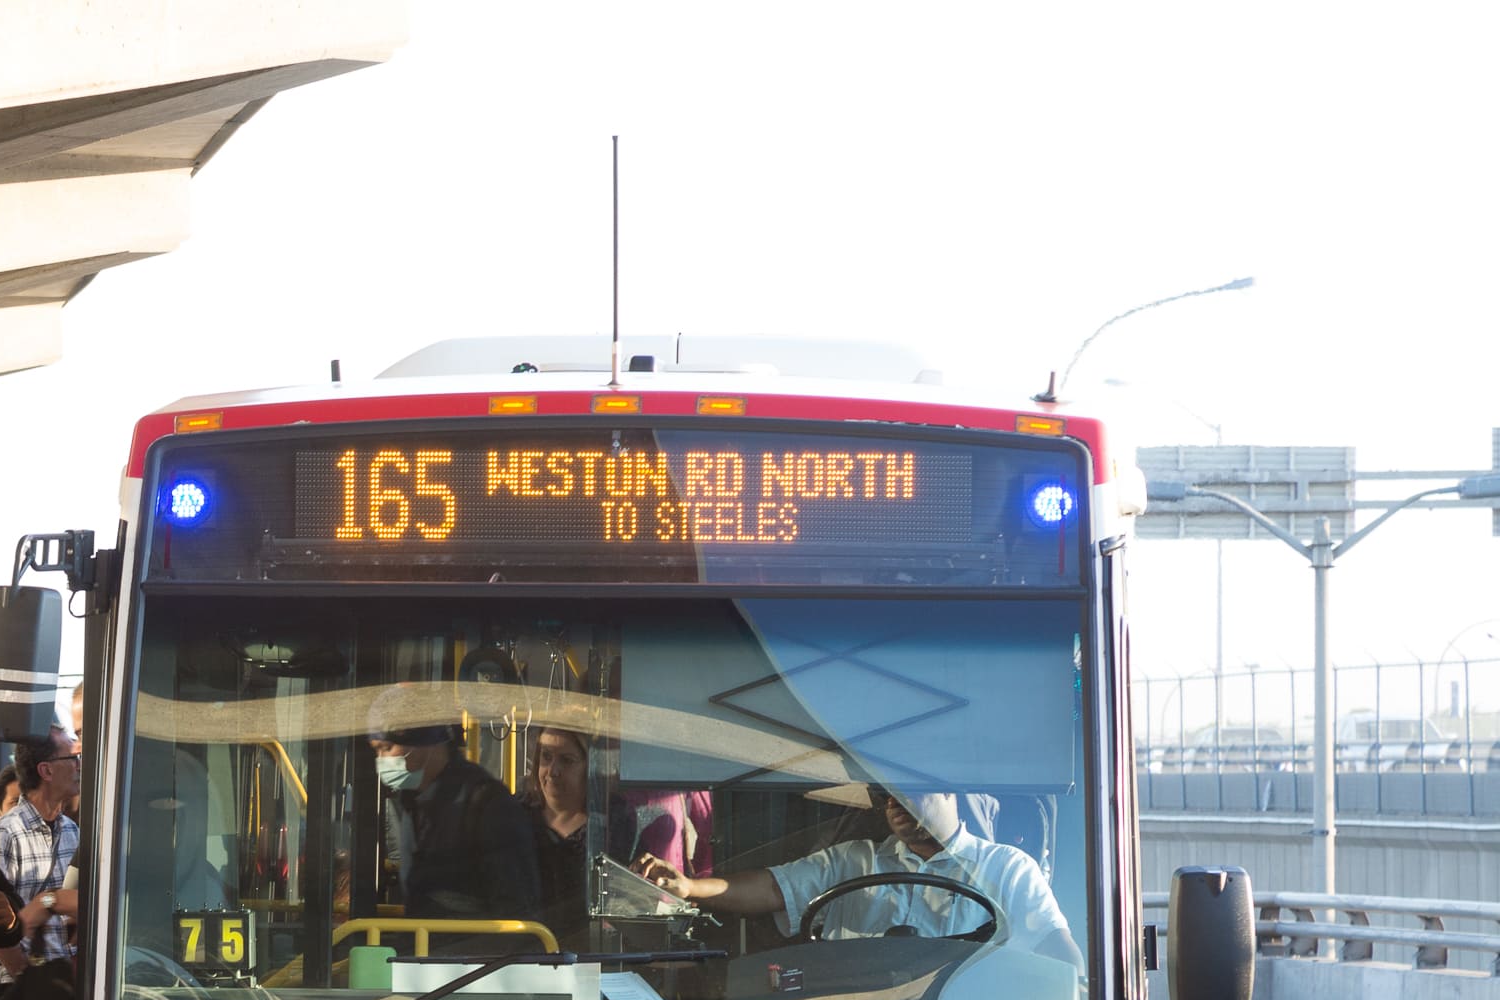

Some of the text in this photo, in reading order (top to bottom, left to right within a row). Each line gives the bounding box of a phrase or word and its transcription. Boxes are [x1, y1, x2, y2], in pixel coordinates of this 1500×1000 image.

[336, 449, 914, 539] 165 WESTON RD NORTH
[601, 501, 798, 541] TO STEELES
